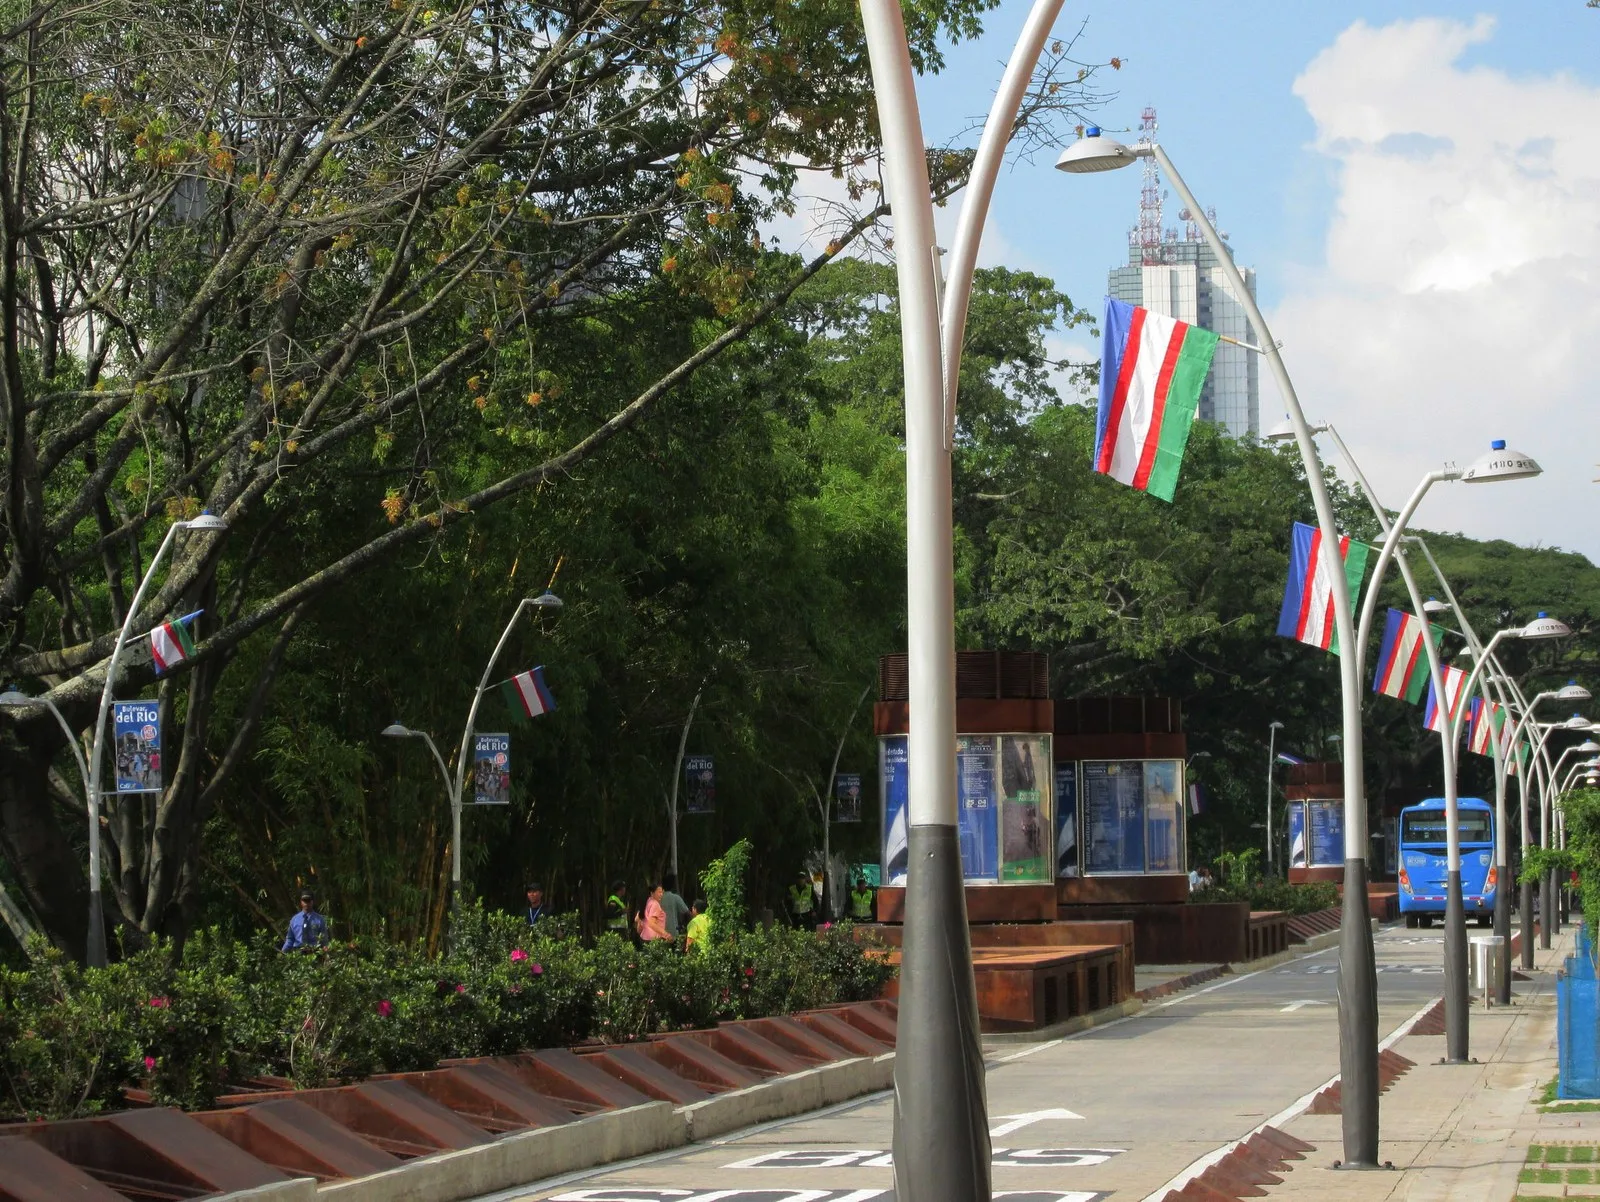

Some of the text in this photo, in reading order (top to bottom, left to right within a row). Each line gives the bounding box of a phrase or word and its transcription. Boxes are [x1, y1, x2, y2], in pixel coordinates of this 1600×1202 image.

[122, 705, 146, 713] Bulevar
[116, 709, 158, 723] del RÍO
[475, 742, 490, 751] del
